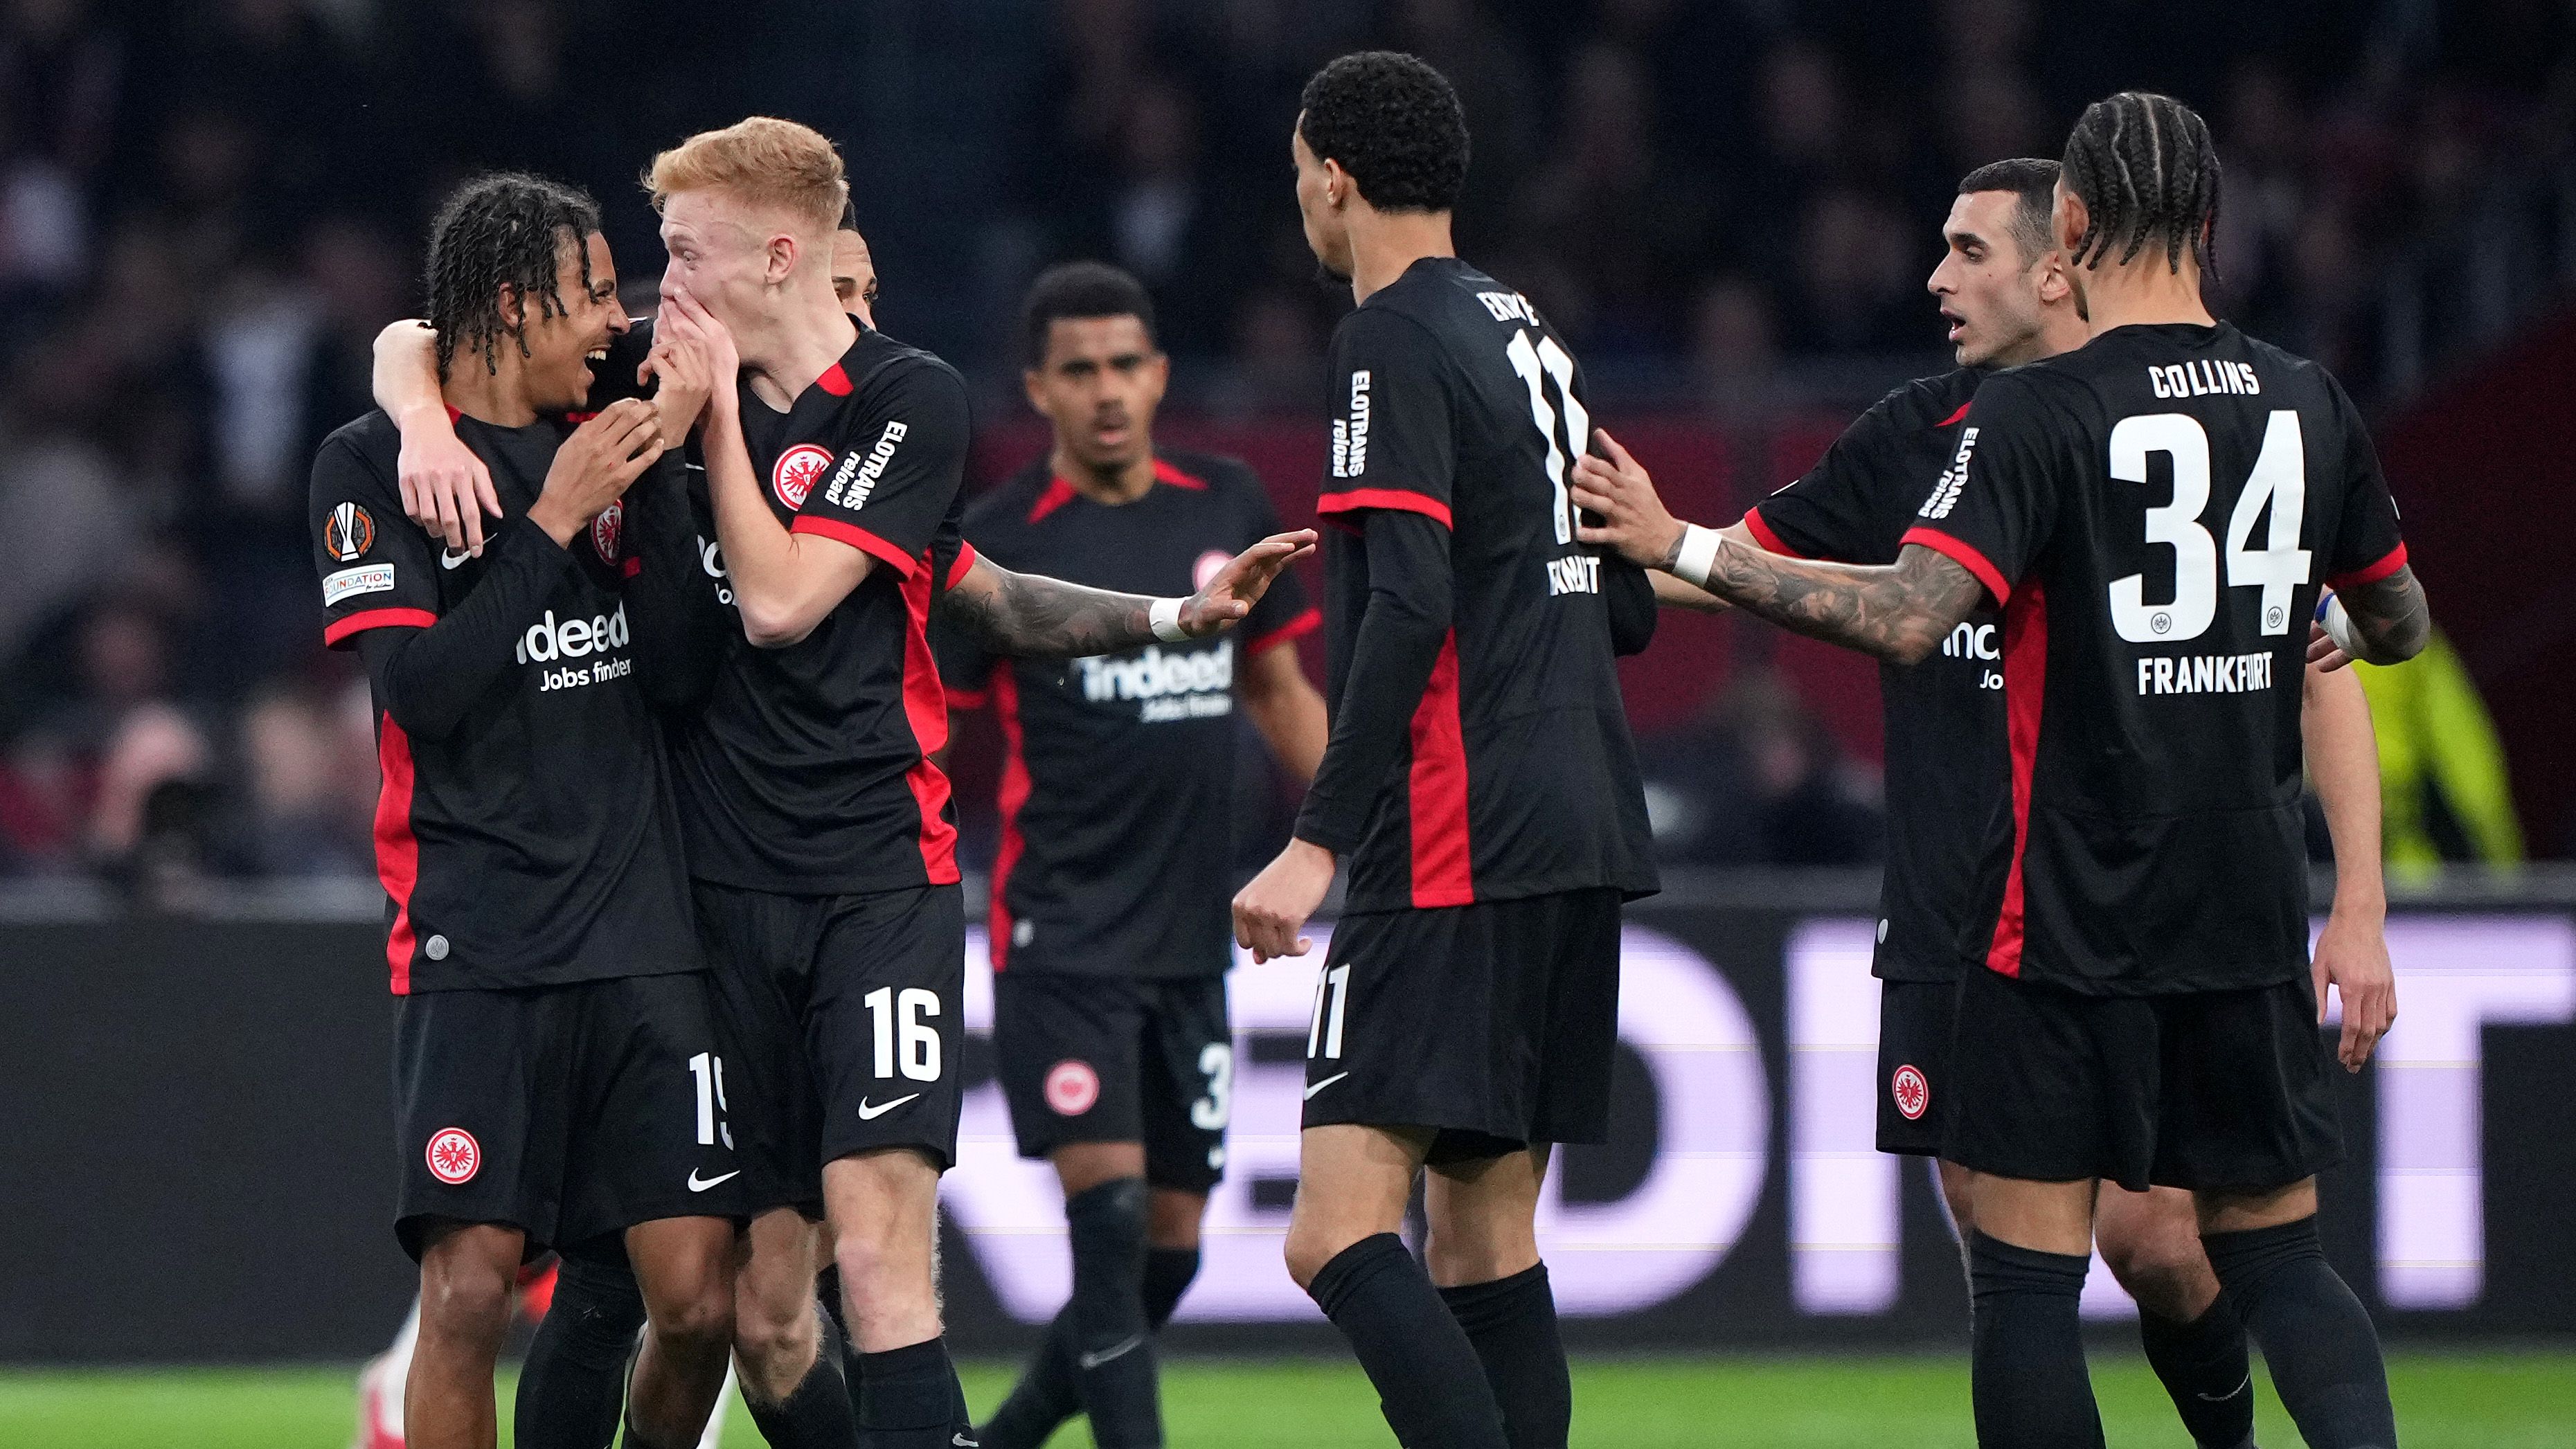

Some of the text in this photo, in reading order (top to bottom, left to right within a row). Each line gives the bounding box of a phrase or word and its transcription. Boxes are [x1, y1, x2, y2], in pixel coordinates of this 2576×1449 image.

[2148, 359, 2260, 399] COLLINS
[1332, 418, 1350, 478] reload
[1348, 370, 1370, 477] ELOTRANS
[1506, 328, 1589, 545] 11
[825, 451, 861, 505] reload
[843, 420, 907, 511] ELOTRANS
[1917, 470, 1954, 517] reload
[1930, 427, 1980, 519] ELOTRANS
[2109, 410, 2312, 642] 34
[325, 572, 391, 595] FOUNDATION
[540, 657, 632, 692] Jobs finder
[2138, 651, 2273, 695] FRANKFURT
[865, 986, 942, 1083] 16
[1307, 963, 1350, 1059] 11
